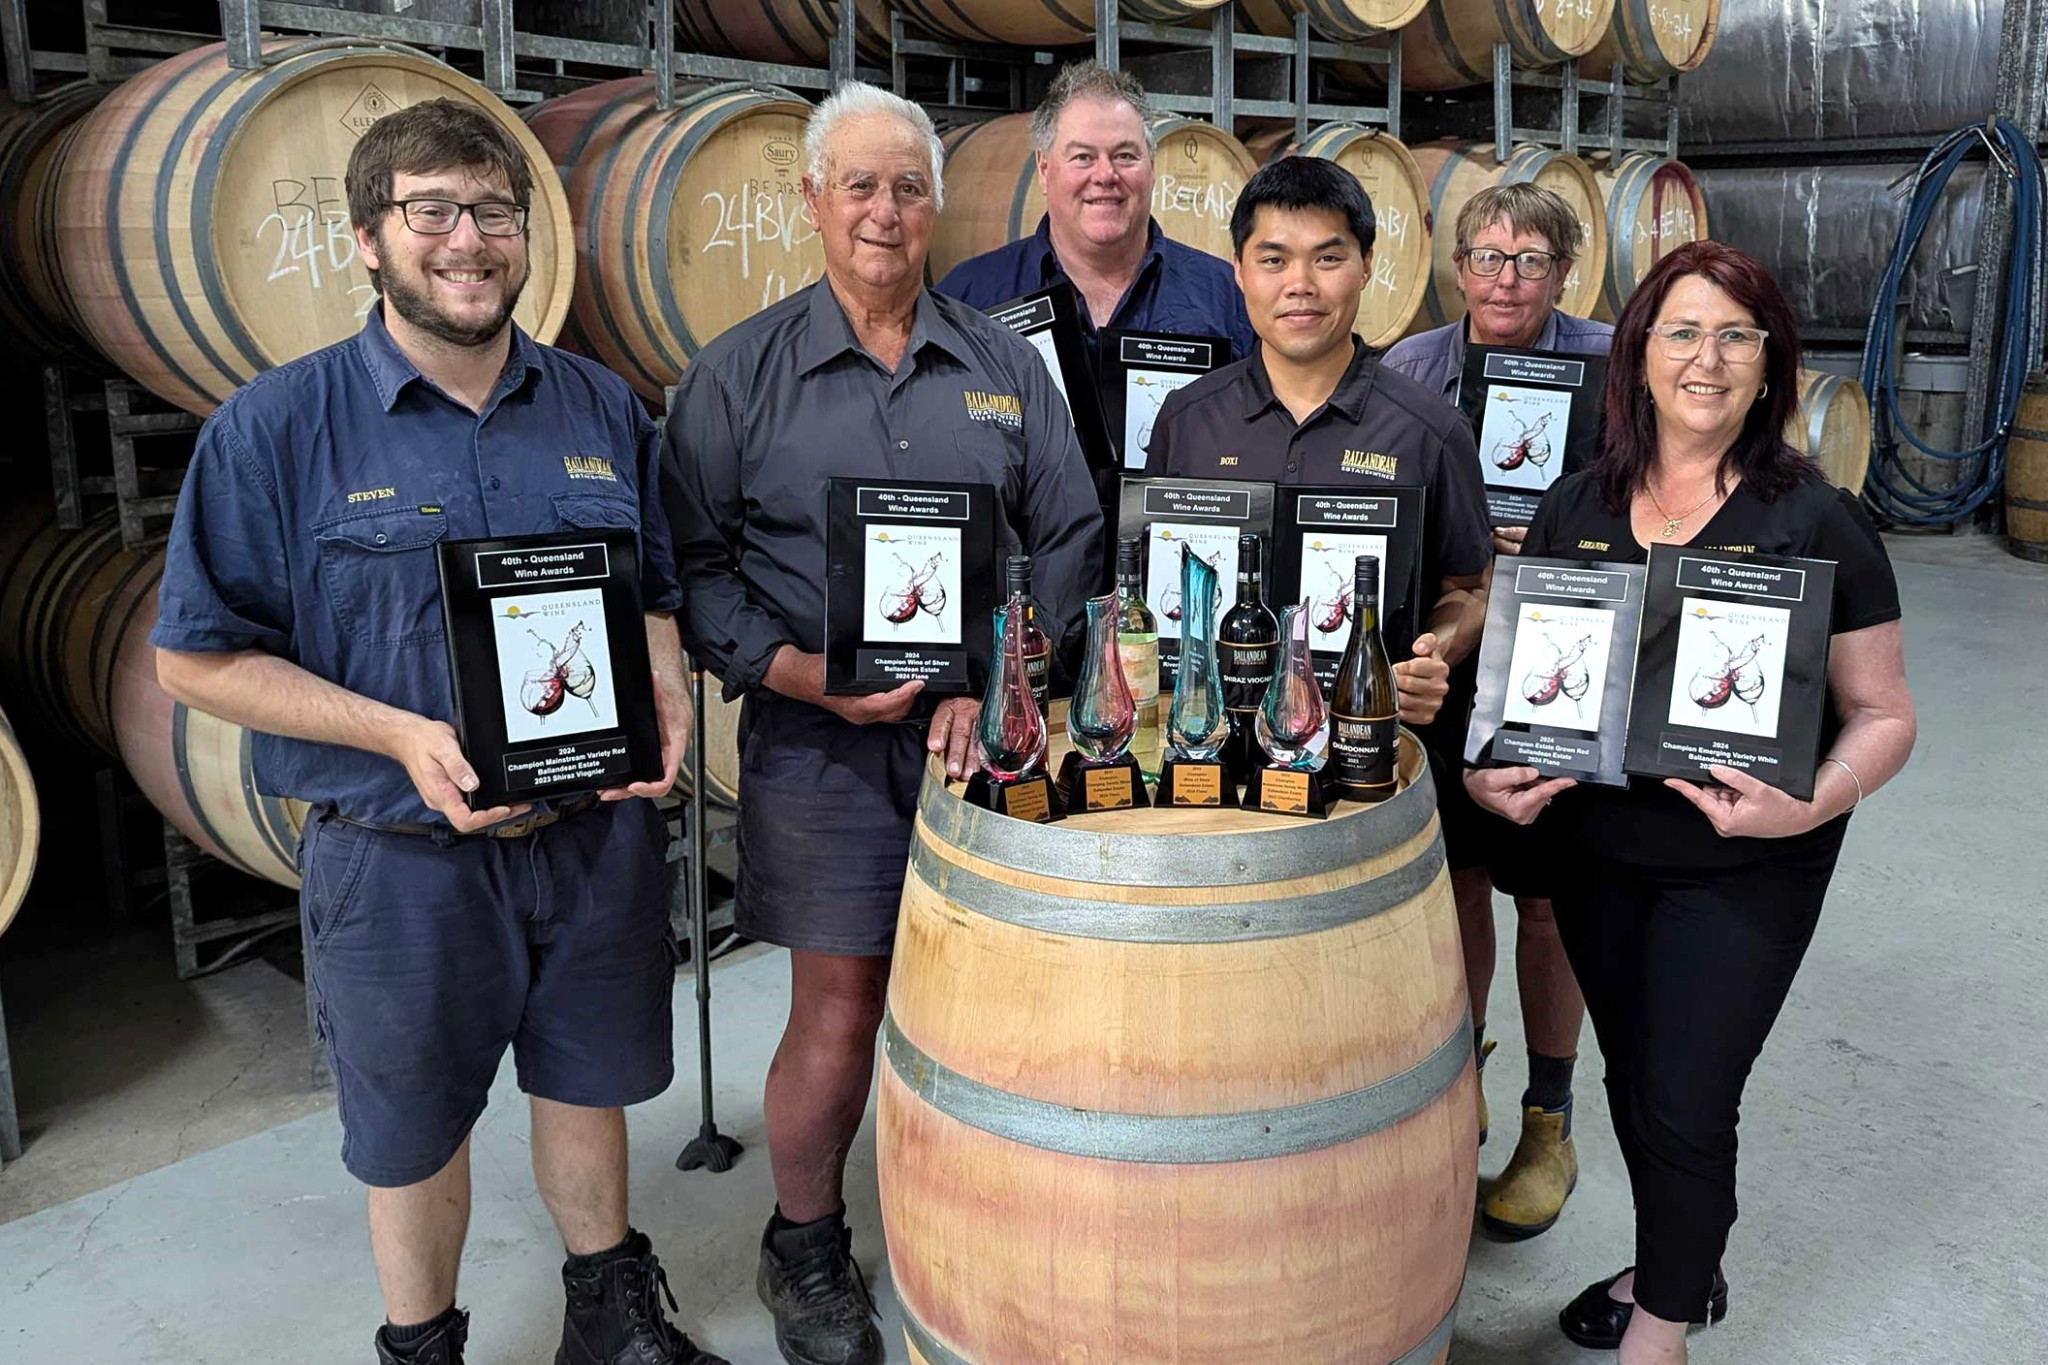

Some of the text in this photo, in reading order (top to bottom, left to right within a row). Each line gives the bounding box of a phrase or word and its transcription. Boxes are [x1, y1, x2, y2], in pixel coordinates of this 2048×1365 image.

[1157, 344, 1195, 354] Queensland
[1162, 354, 1187, 362] Awards
[1524, 361, 1566, 371] Queensland
[1511, 369, 1555, 379] Wine Awards
[1341, 449, 1398, 474] BALLANDEAN
[347, 487, 395, 503] STEVEN
[878, 493, 896, 501] 40th
[902, 494, 949, 504] Queensland
[1163, 492, 1180, 500] 40th
[1186, 493, 1231, 502] Queensland
[887, 504, 939, 514] Wine Awards
[1172, 503, 1221, 513] Wine Awards
[1315, 501, 1331, 509] 40th
[1336, 501, 1378, 510] Queensland
[1323, 512, 1369, 521] Wine Awards
[501, 557, 522, 566] 40th
[530, 551, 584, 564] Queensland
[514, 566, 575, 579] Wine Awards
[1537, 572, 1555, 580] 40th
[1560, 573, 1608, 584] Queensland
[1701, 565, 1720, 574] 40th
[1727, 568, 1781, 581] Queensland
[1545, 583, 1596, 594] Wine Awards
[1711, 578, 1768, 591] Wine Awards
[541, 599, 601, 611] QUEENSLAND
[1233, 650, 1268, 660] BALLANDEAN
[874, 658, 907, 666] Champion
[1223, 674, 1246, 684] SHIRAZ
[1332, 741, 1380, 753] CHARDONNAY
[1503, 738, 1590, 755] Champion Estate Grown Red
[1712, 741, 1729, 749] 2024
[558, 746, 576, 756] 2024
[1518, 747, 1572, 760] Ballandean Estate
[1662, 742, 1778, 764] Champion Emerging Variety White
[508, 747, 626, 772] Champion Mainstream Variety Red
[1543, 758, 1560, 766] Fiano
[1688, 753, 1750, 768] Ballandean Estate
[537, 760, 600, 776] Ballandean Estate
[1699, 762, 1712, 770] 202
[552, 773, 575, 782] Shiraz
[576, 767, 606, 778] Viognier
